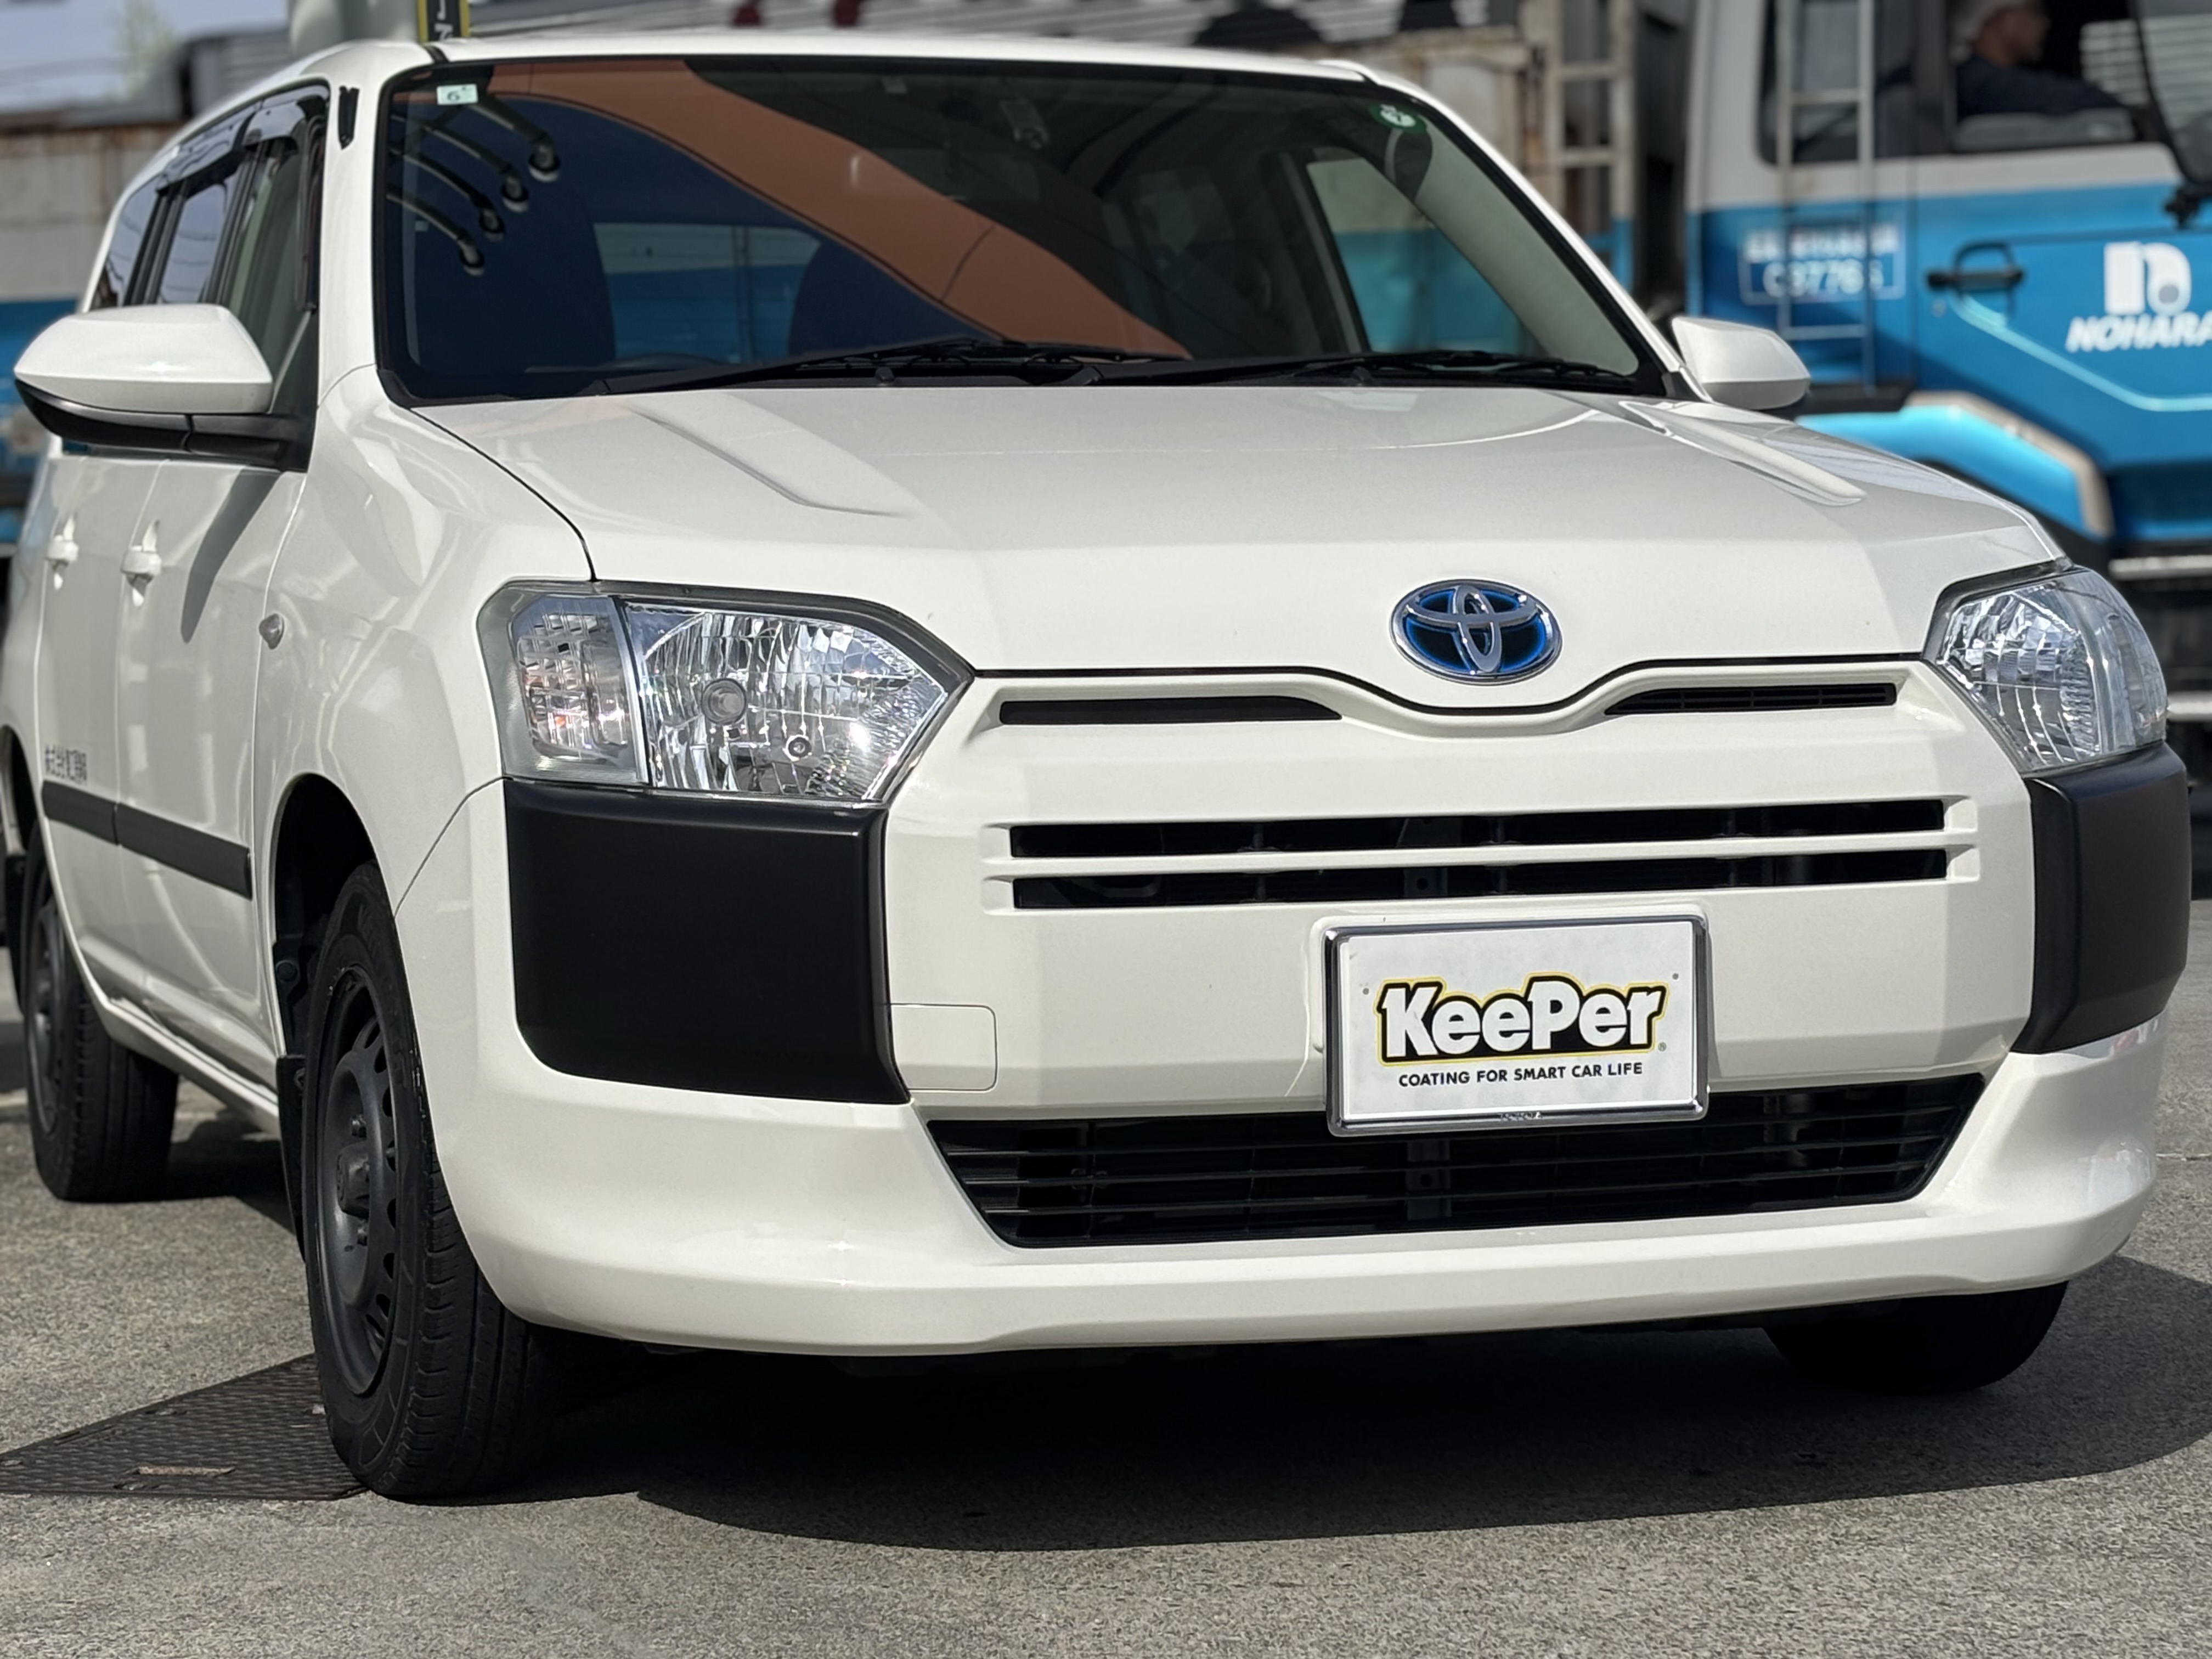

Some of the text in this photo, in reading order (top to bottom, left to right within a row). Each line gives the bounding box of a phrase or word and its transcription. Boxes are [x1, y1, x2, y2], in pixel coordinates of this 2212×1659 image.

[1379, 979, 1663, 1059] KeePer
[1398, 1062, 1643, 1087] COATING FOR SMART CAR LIFE
